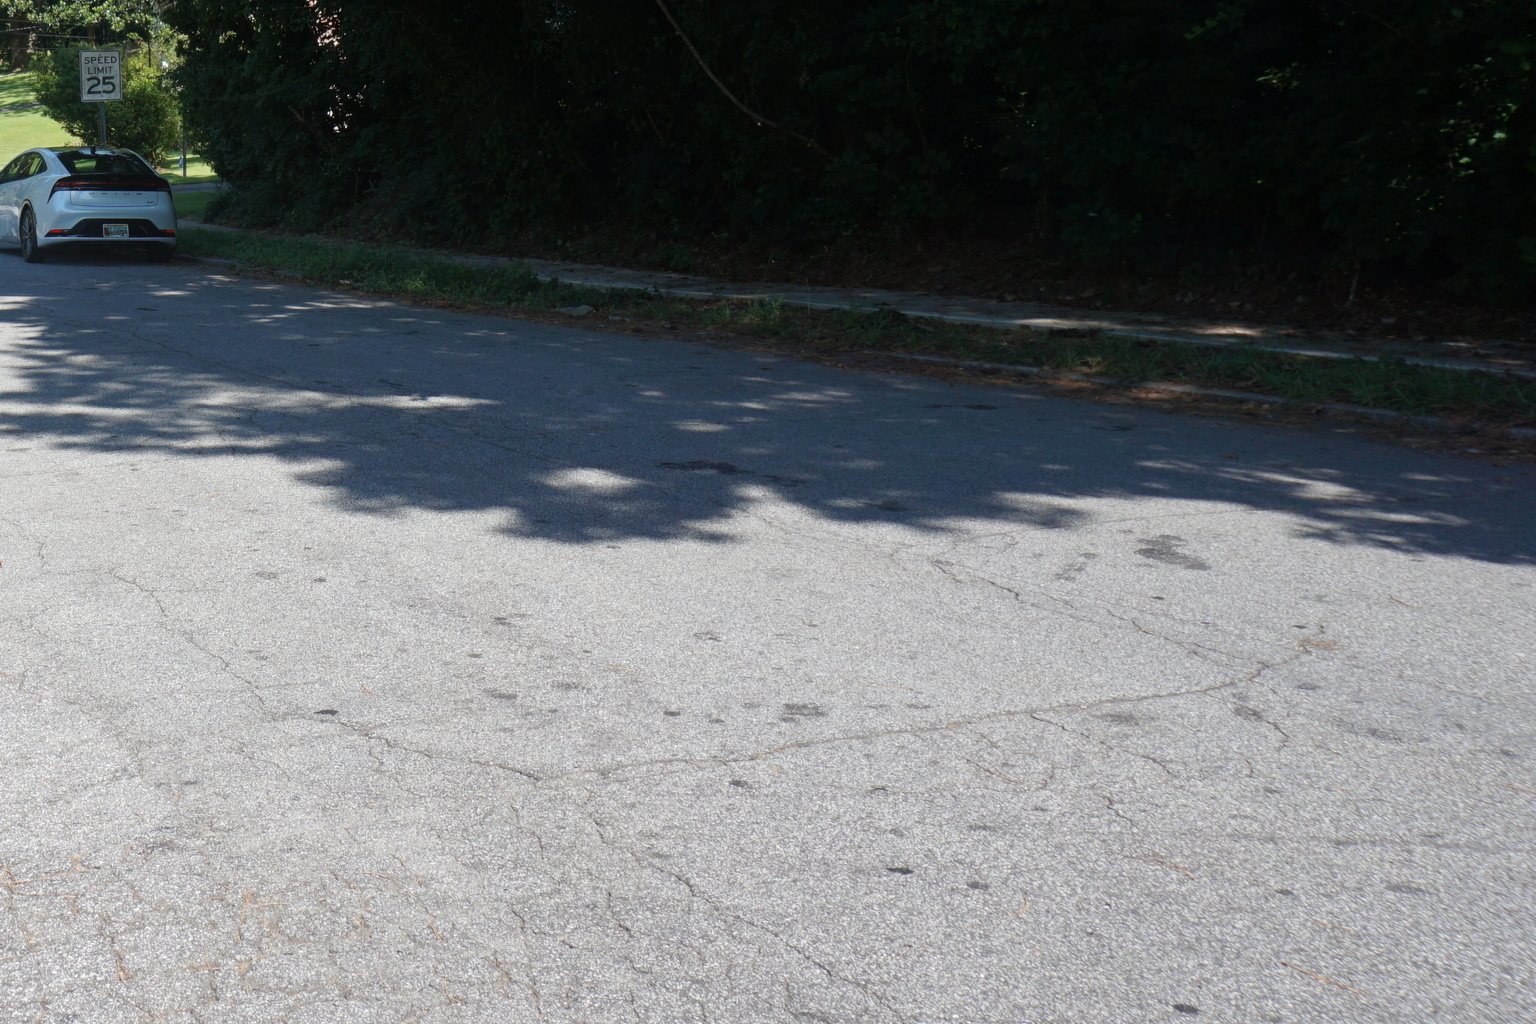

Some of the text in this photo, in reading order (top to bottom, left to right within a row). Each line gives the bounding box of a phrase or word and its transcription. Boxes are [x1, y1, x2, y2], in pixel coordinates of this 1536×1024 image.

[84, 56, 117, 64] SPEED
[88, 66, 113, 75] LIMIT
[86, 76, 116, 95] 25
